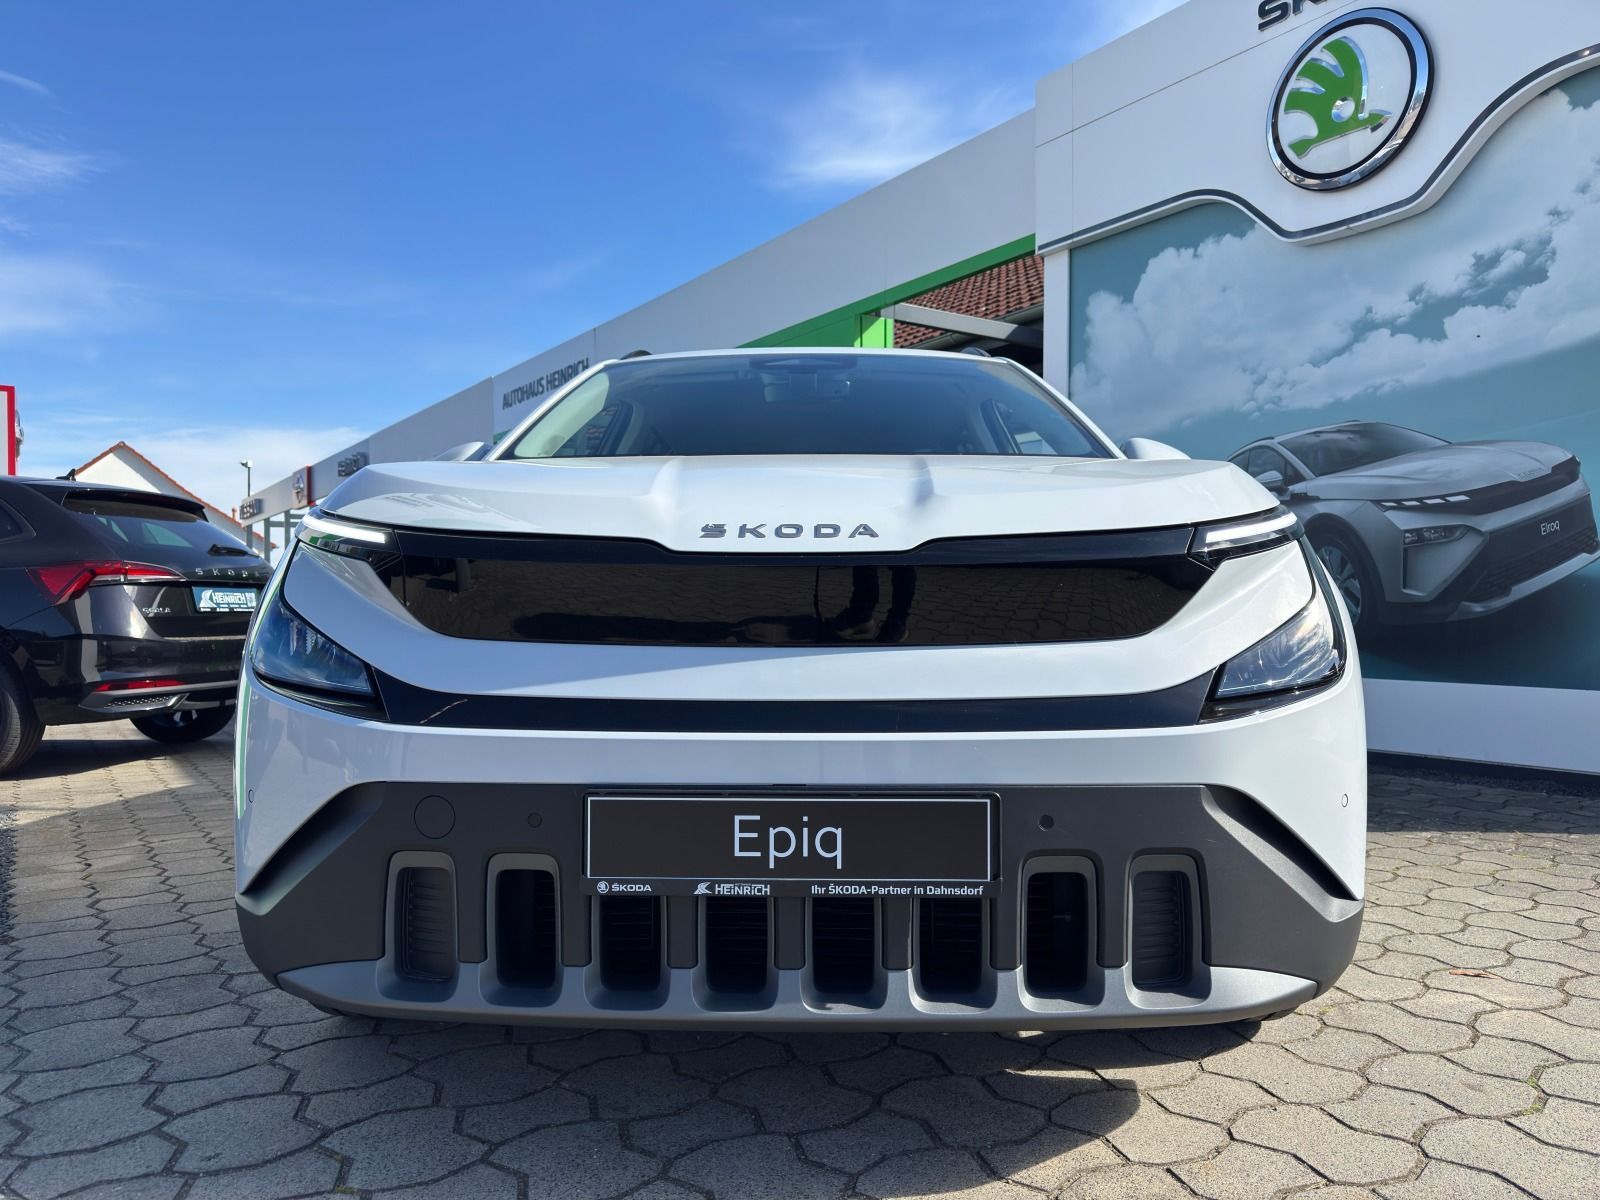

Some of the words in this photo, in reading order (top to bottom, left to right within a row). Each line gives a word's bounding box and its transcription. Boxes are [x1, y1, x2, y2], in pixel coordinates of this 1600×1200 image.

[502, 376, 545, 410] AUTOHAUS
[546, 358, 589, 392] HEINRICH
[1541, 520, 1560, 535] Elroq
[734, 815, 842, 869] Epiq
[611, 883, 652, 892] ŠKODA
[811, 885, 826, 895] Ihr
[828, 883, 912, 895] ŠKODA-Partner
[914, 886, 924, 895] in
[926, 885, 984, 896] Dahnsdorf
